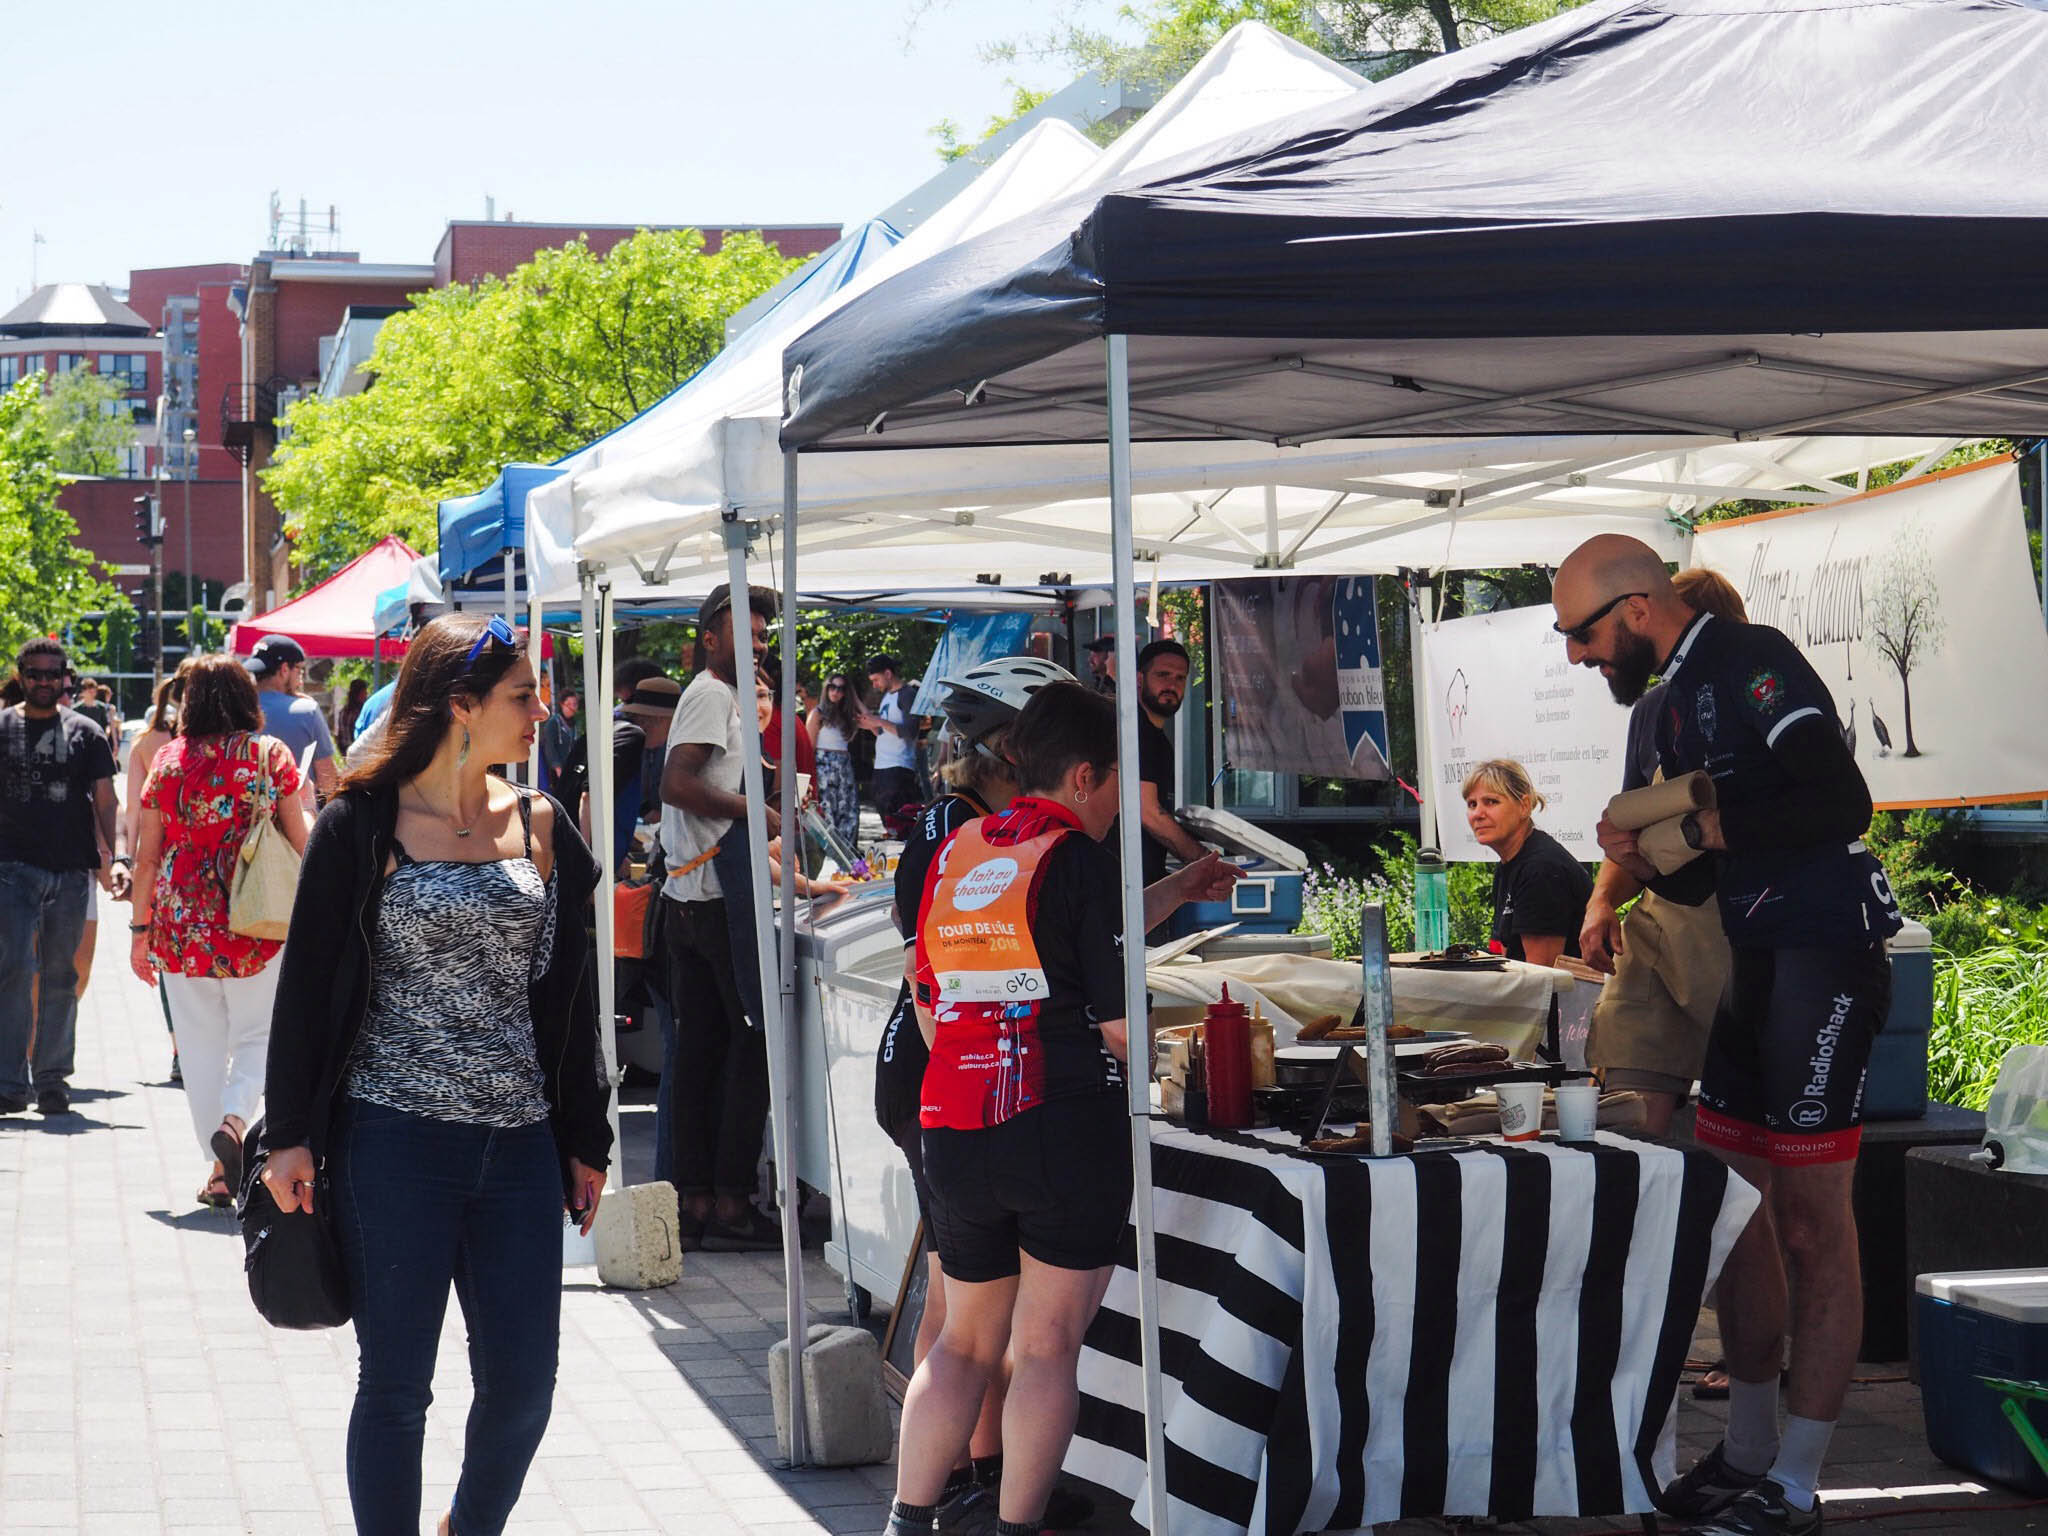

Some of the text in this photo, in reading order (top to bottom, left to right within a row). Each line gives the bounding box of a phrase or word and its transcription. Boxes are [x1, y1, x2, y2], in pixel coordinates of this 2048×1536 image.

[1340, 686, 1365, 705] ruban
[1550, 747, 1581, 761] Commande
[969, 868, 1013, 882] lait au
[955, 881, 1008, 897] chocolat
[937, 922, 974, 938] TOUR
[975, 922, 992, 935] DE
[953, 936, 987, 945] MONTRÉAL
[989, 936, 1021, 952] 2018
[1803, 993, 1854, 1097] RadioShack
[1696, 1112, 1741, 1137] NONIMO
[1774, 1140, 1837, 1154] ANONIMO
